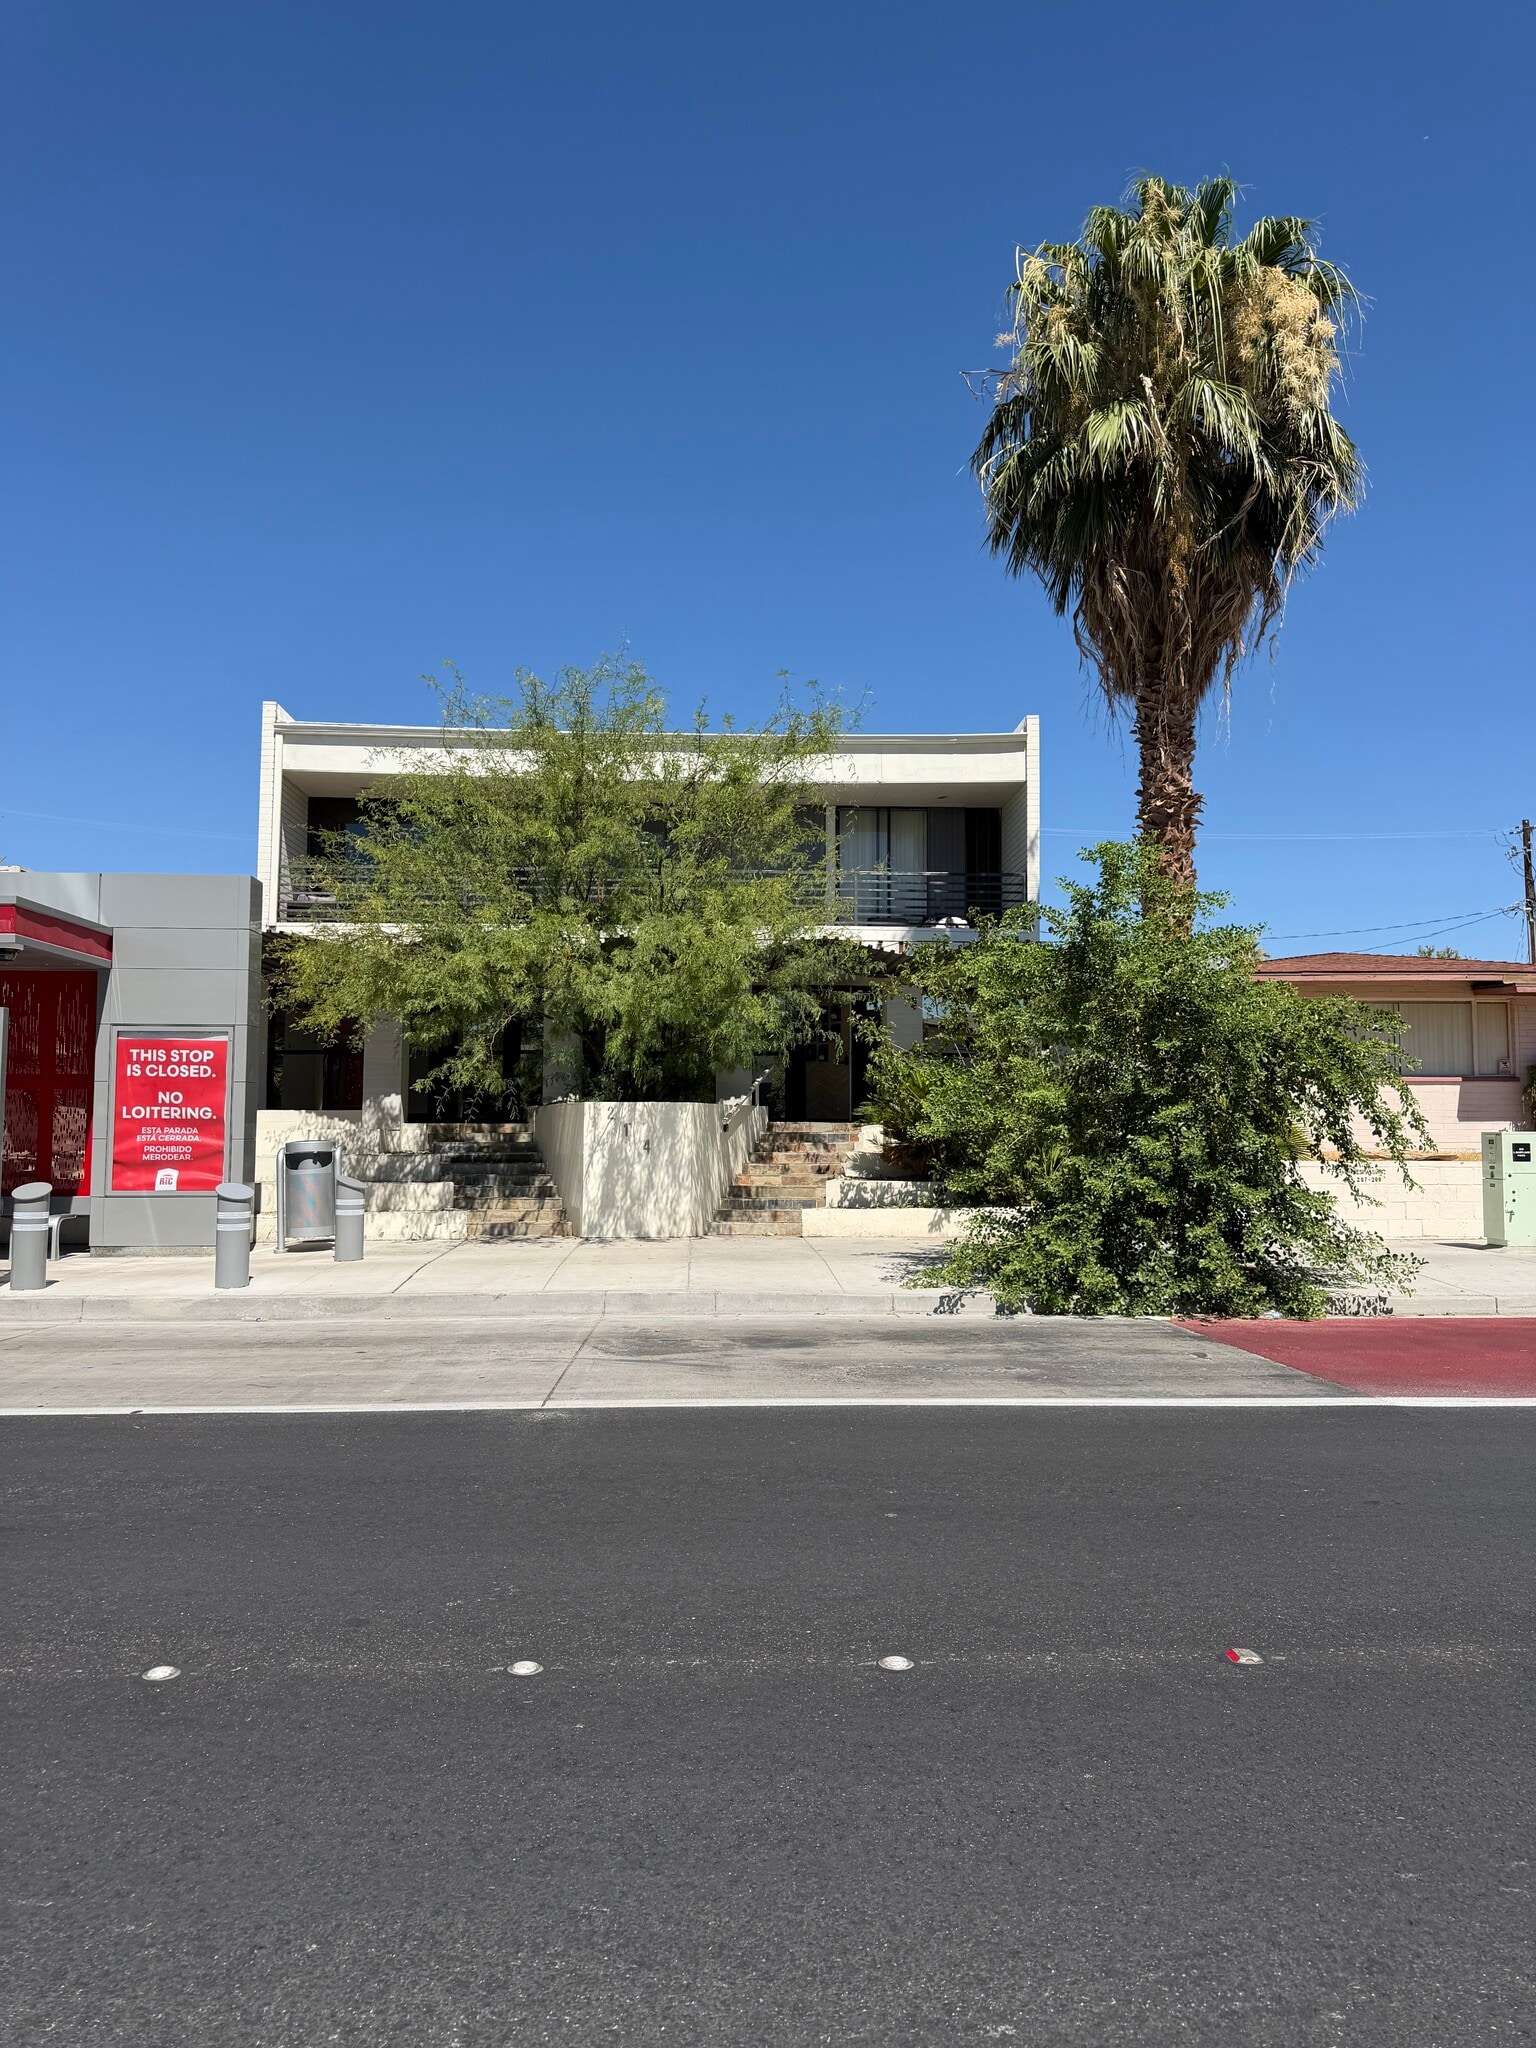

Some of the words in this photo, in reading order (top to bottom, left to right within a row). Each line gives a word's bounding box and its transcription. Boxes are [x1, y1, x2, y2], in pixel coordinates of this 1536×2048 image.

[130, 1049, 167, 1062] THIS
[170, 1049, 214, 1063] STOP
[126, 1064, 142, 1077] IS
[145, 1064, 217, 1078] CLOSED.
[158, 1091, 184, 1104] NO
[122, 1106, 217, 1120] LOITERING.
[141, 1126, 162, 1134] ESTA
[163, 1126, 199, 1134] PARADA
[136, 1134, 157, 1142] ESTÁ
[143, 1145, 193, 1153] PROHIBIDO
[142, 1153, 194, 1161] MERODEAR.
